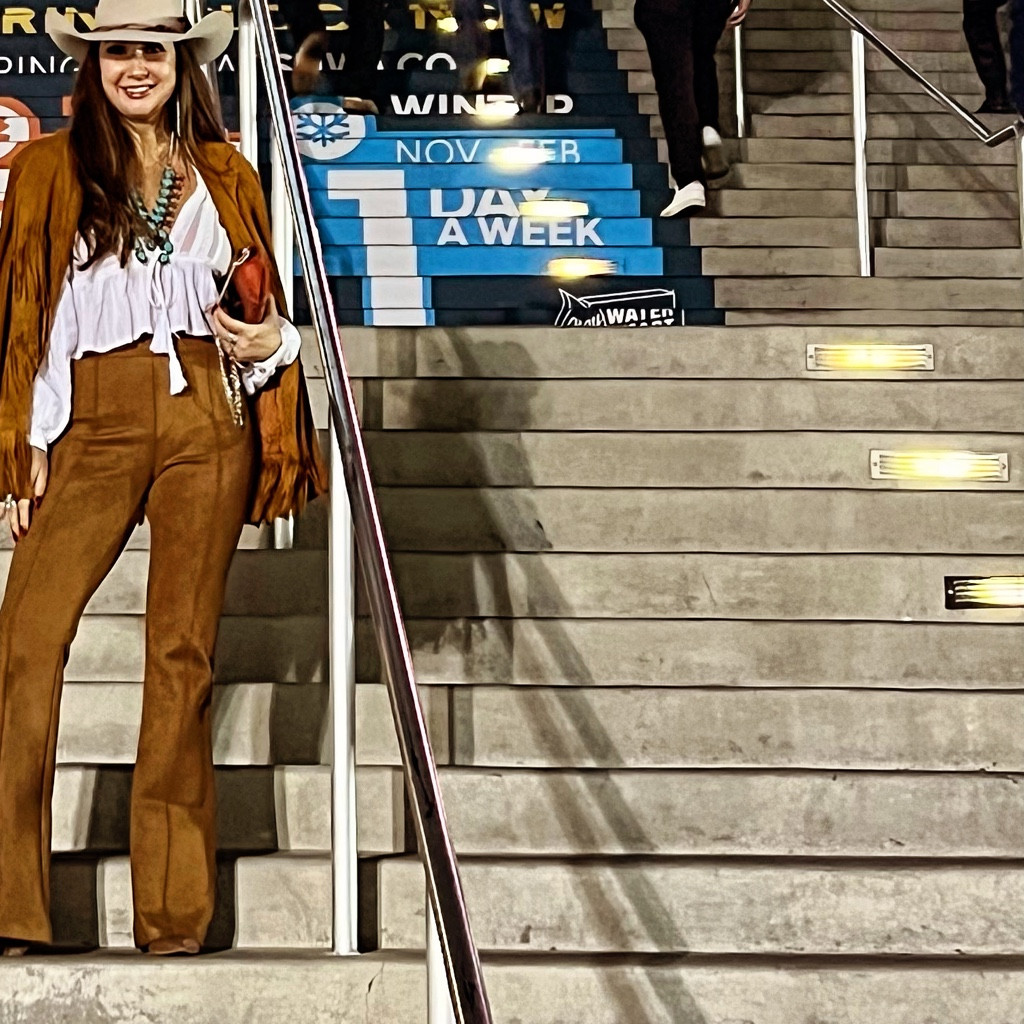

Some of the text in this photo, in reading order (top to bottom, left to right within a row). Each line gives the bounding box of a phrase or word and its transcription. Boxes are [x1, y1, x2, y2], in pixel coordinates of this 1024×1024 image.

[396, 138, 482, 164] NOV
[437, 217, 605, 247] A WEEK
